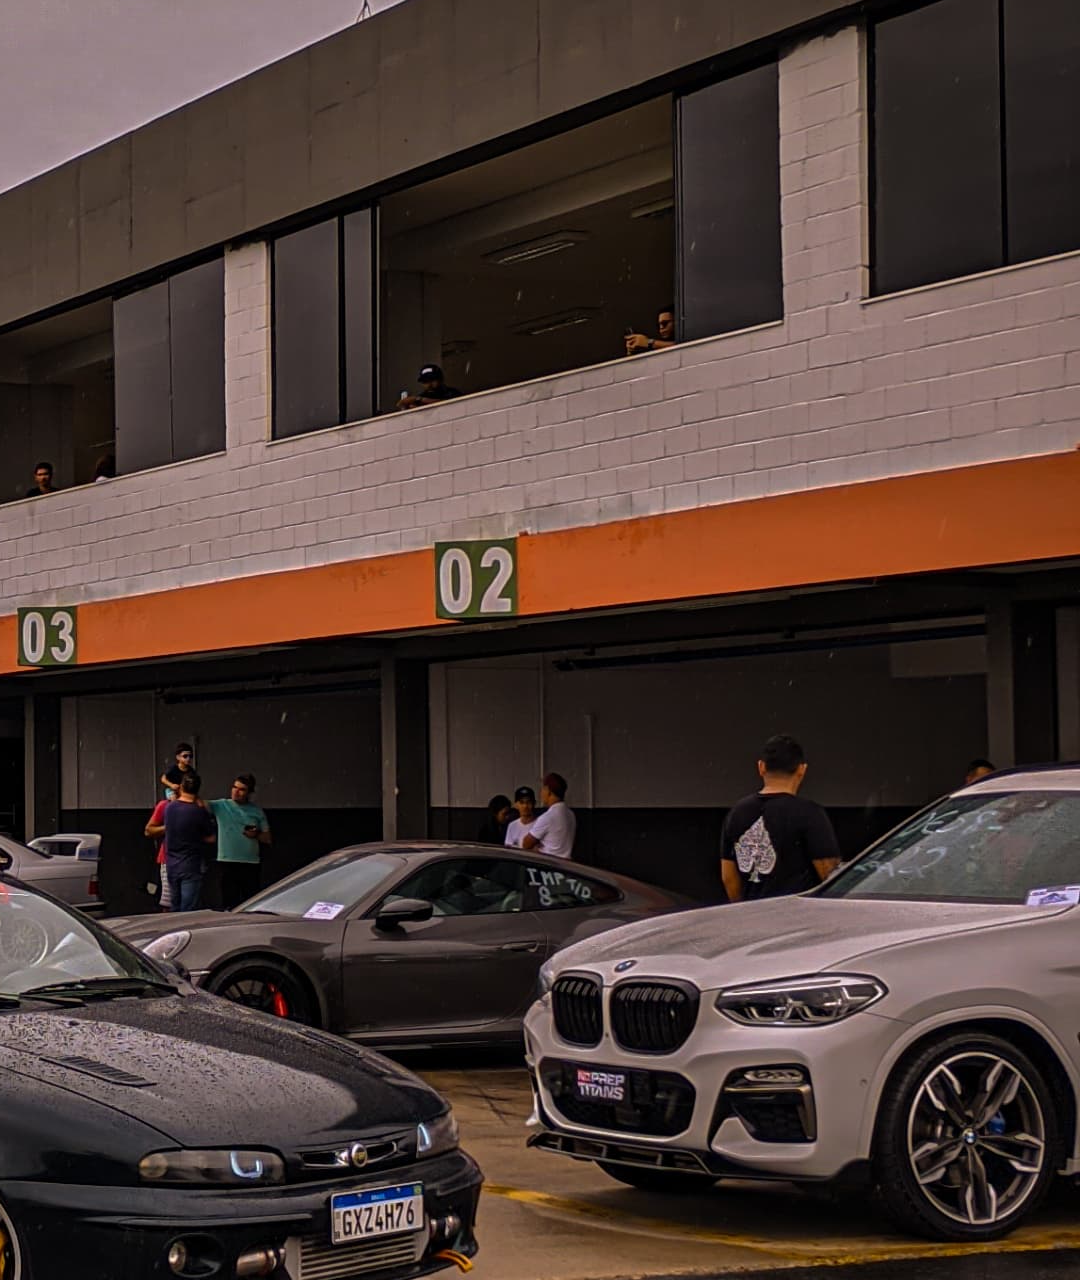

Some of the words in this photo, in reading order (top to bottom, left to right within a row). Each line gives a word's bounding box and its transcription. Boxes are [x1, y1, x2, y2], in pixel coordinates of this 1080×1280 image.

[438, 546, 514, 615] 02
[22, 610, 76, 663] 03
[591, 1071, 625, 1086] PREP
[342, 1200, 415, 1236] GXZ4H76
